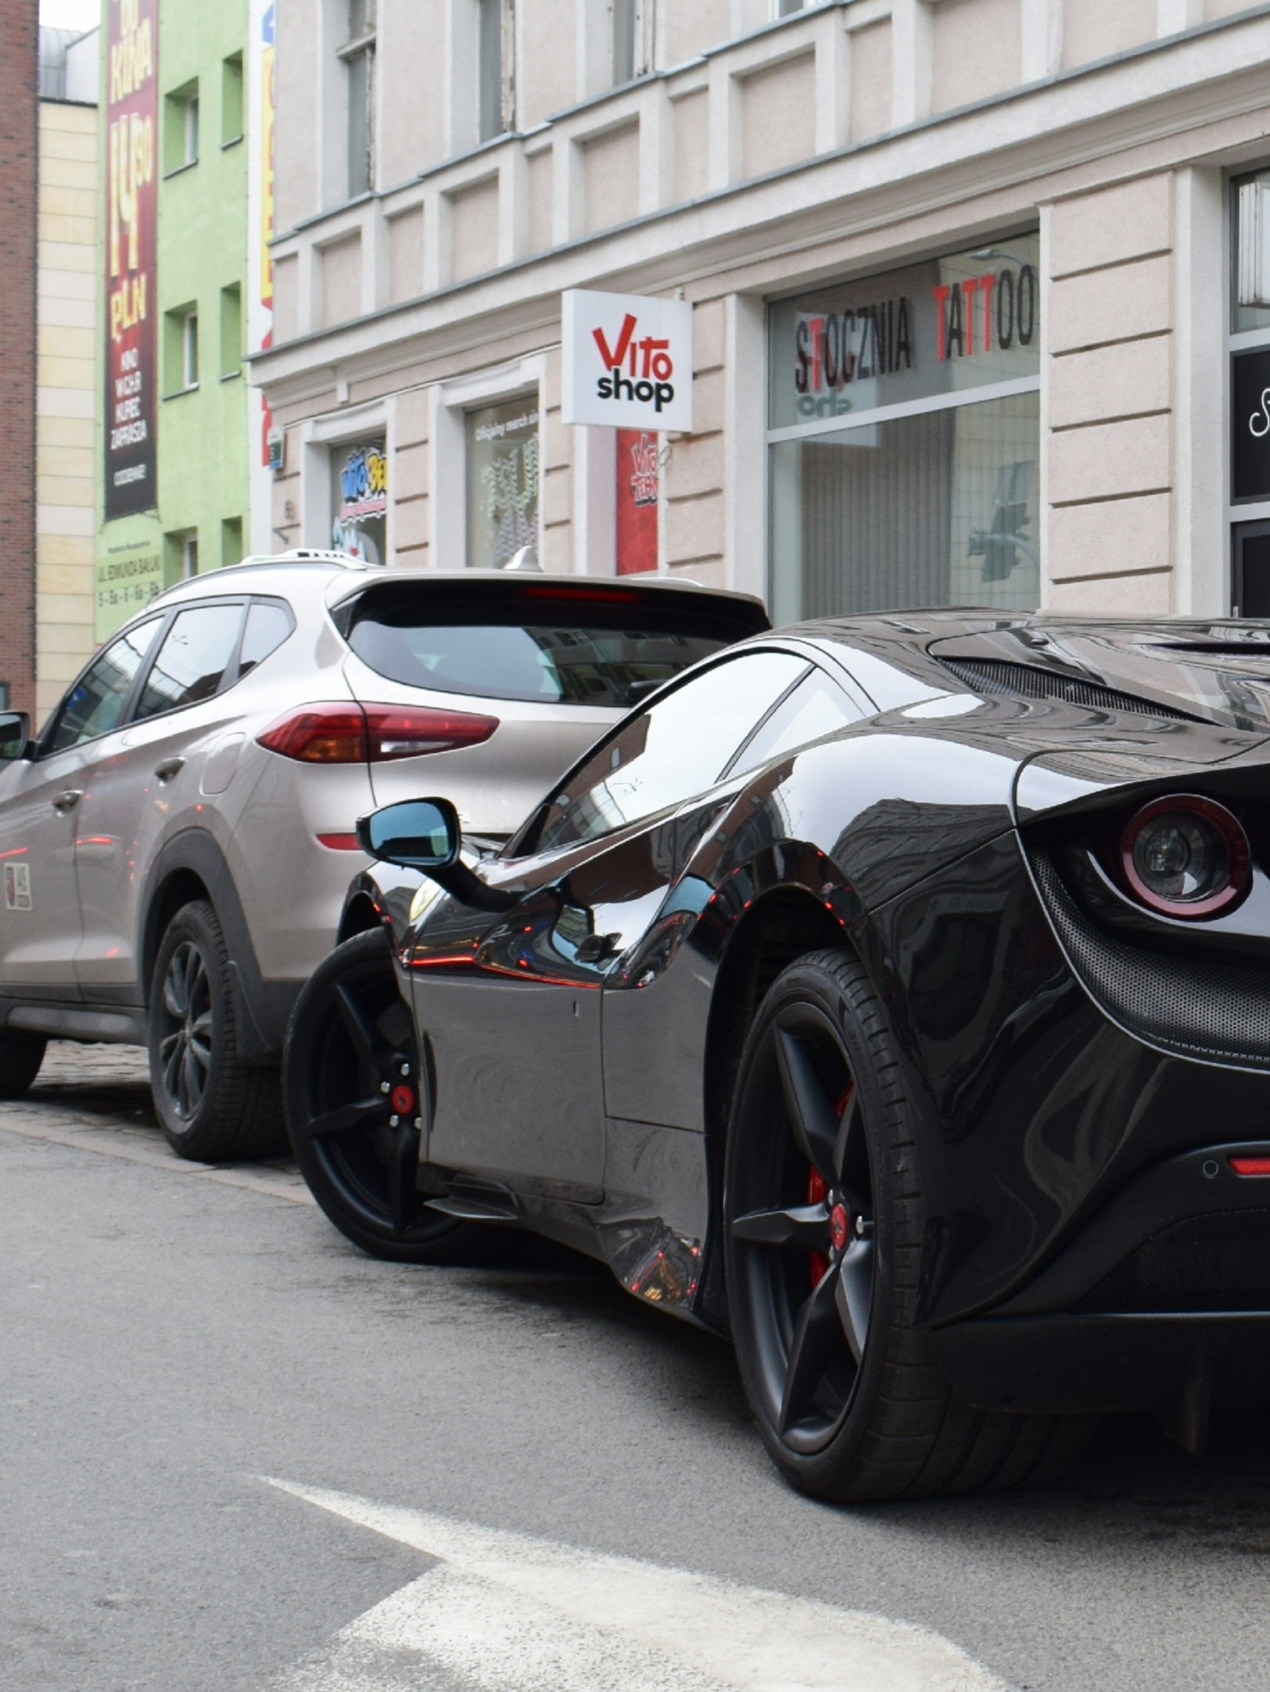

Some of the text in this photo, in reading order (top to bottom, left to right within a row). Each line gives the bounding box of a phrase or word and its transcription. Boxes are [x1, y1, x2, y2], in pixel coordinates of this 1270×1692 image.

[111, 272, 146, 339] PLN
[795, 264, 1035, 394] STOCZNIA TATTOO
[597, 367, 675, 413] shop
